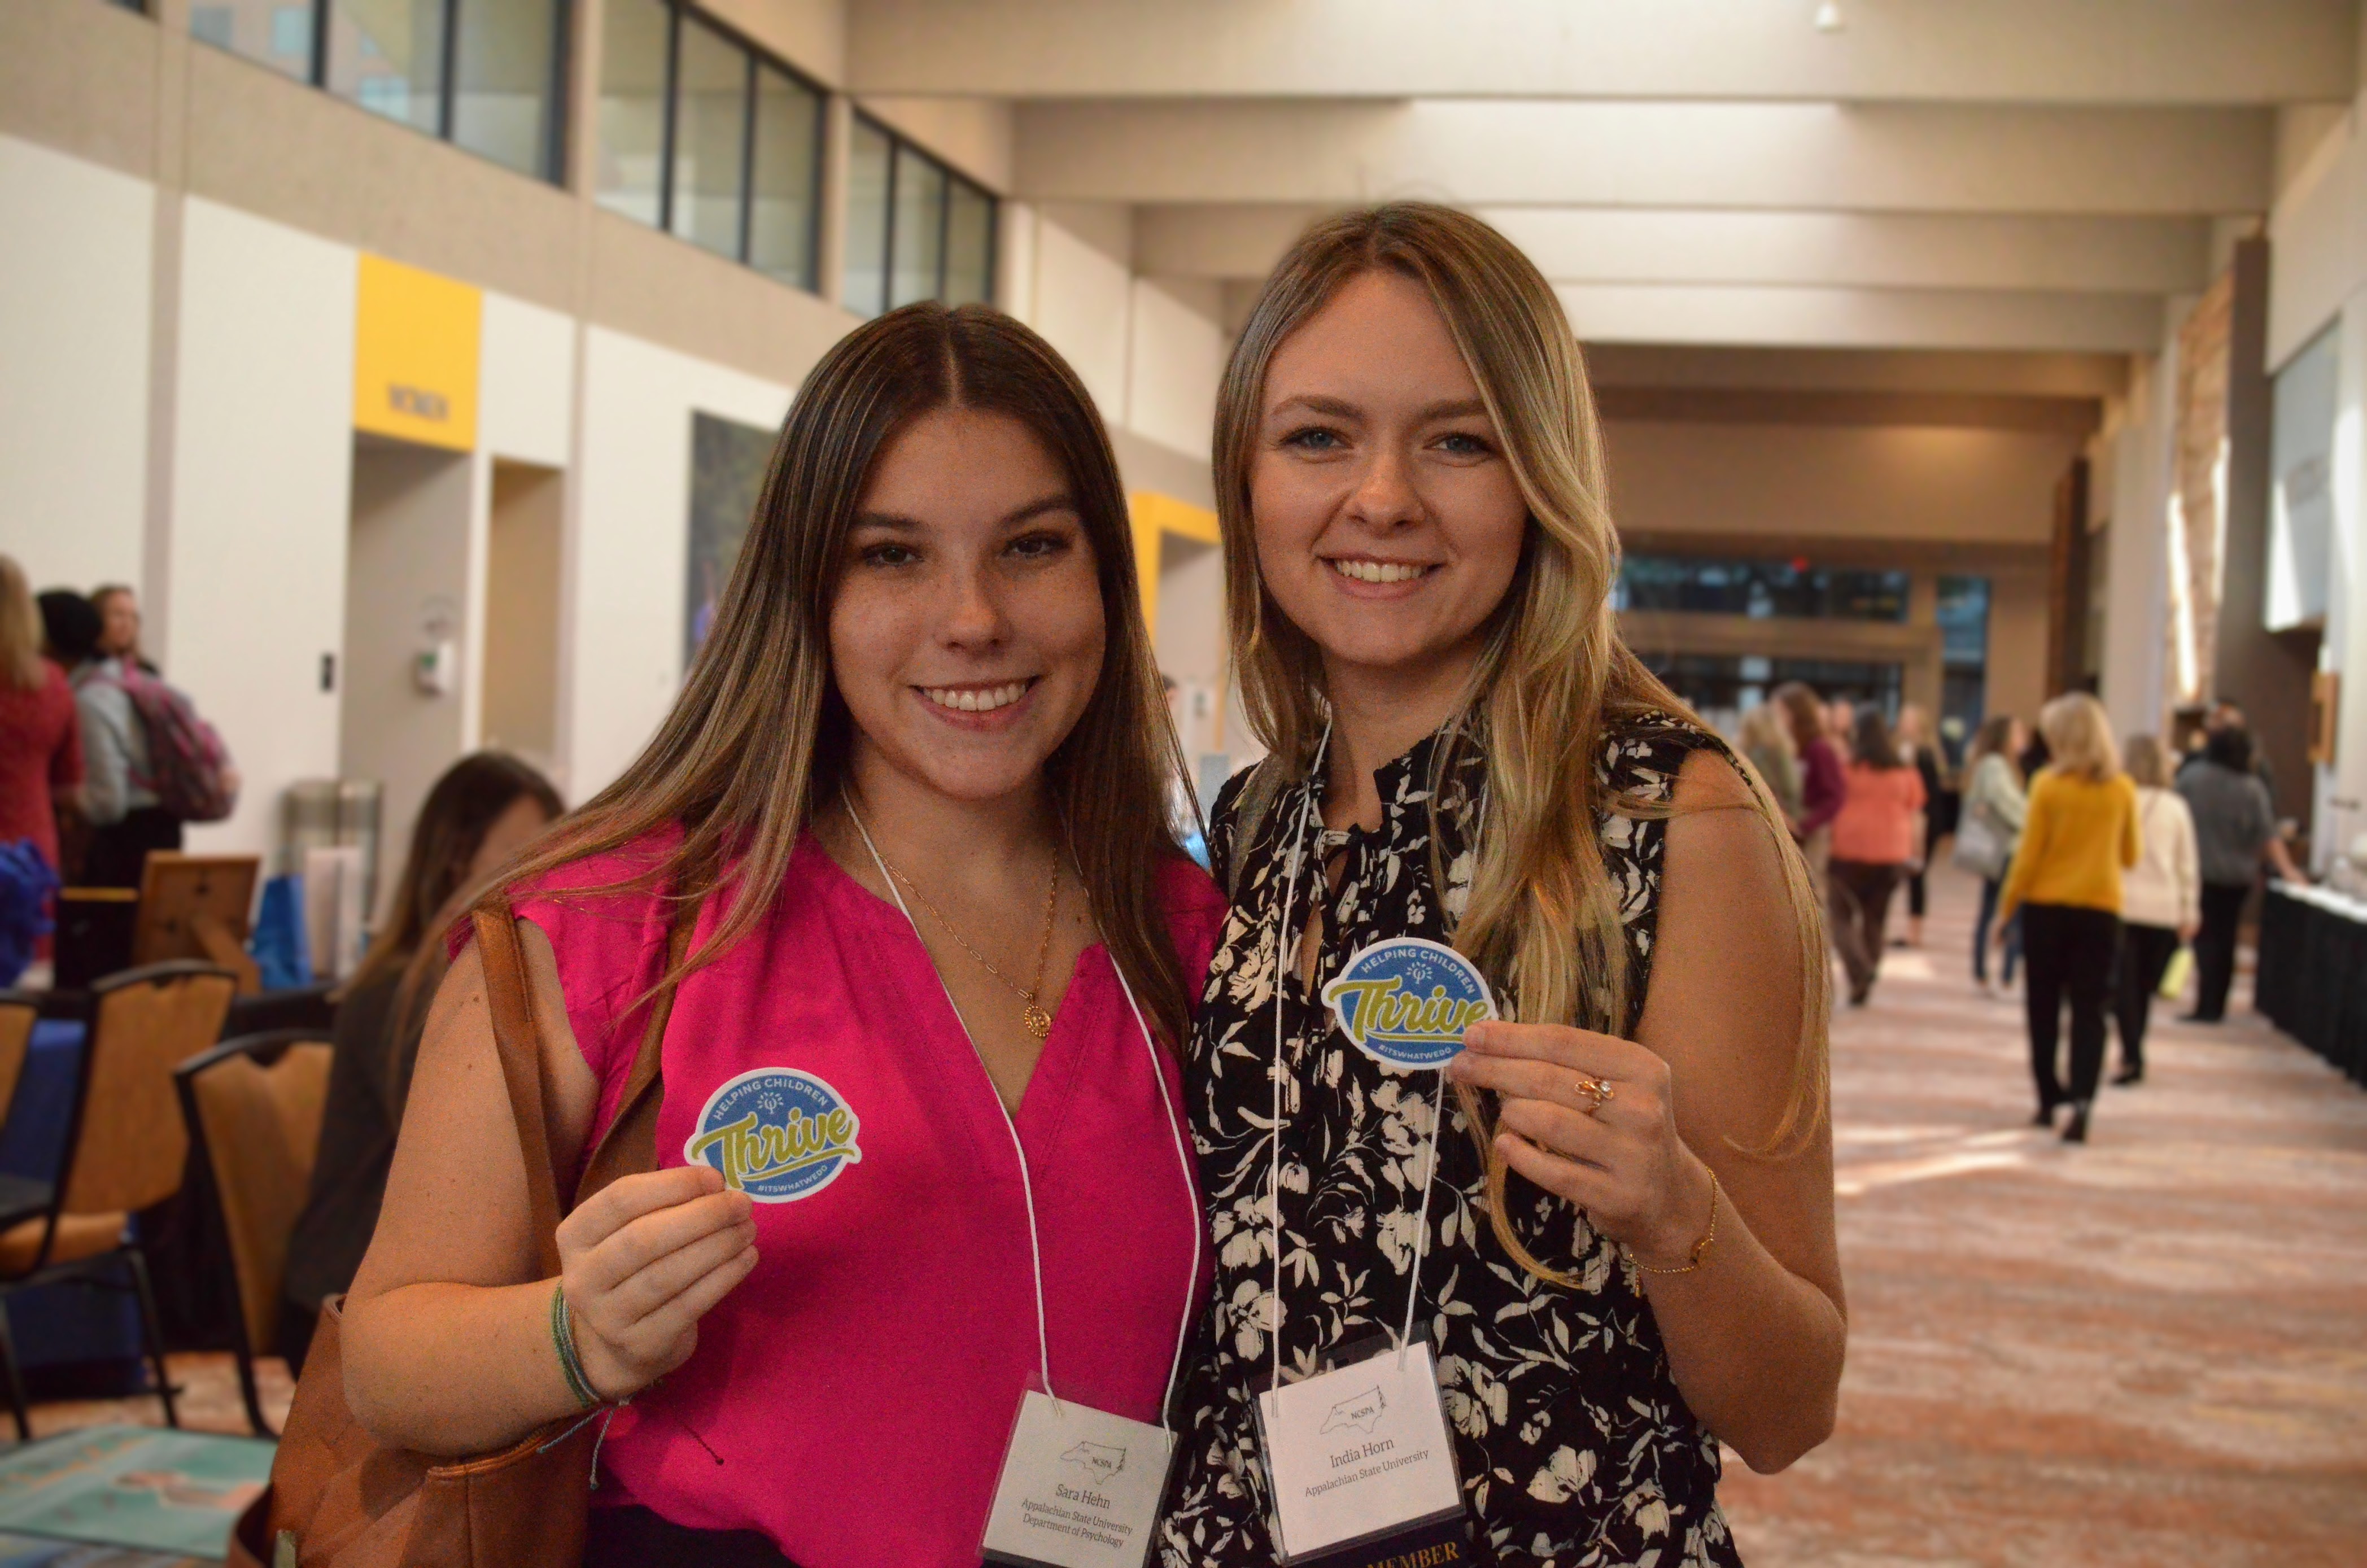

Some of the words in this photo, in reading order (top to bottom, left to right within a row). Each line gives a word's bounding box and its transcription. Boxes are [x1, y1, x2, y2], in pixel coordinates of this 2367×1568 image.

[1361, 948, 1416, 973] HELPING
[1420, 950, 1475, 994] CHILDREN
[1327, 975, 1491, 1042] Thrive
[714, 1080, 761, 1120] HELPING
[764, 1078, 828, 1107] CHILDREN
[691, 1106, 853, 1190] Thrive
[1351, 1406, 1374, 1420] NCSPA
[1305, 1473, 1358, 1497] Appalachian
[1359, 1464, 1381, 1479] State
[1383, 1449, 1429, 1471] University
[1330, 1448, 1360, 1468] India
[1362, 1438, 1394, 1457] Horn
[1055, 1483, 1079, 1501] Sara
[1082, 1490, 1111, 1509] Hehn
[1021, 1498, 1071, 1519] Appalachian
[1073, 1510, 1091, 1524] State
[1093, 1516, 1133, 1536] University
[1023, 1513, 1070, 1534] Department
[1071, 1526, 1081, 1536] of
[1081, 1527, 1124, 1548] Psychology
